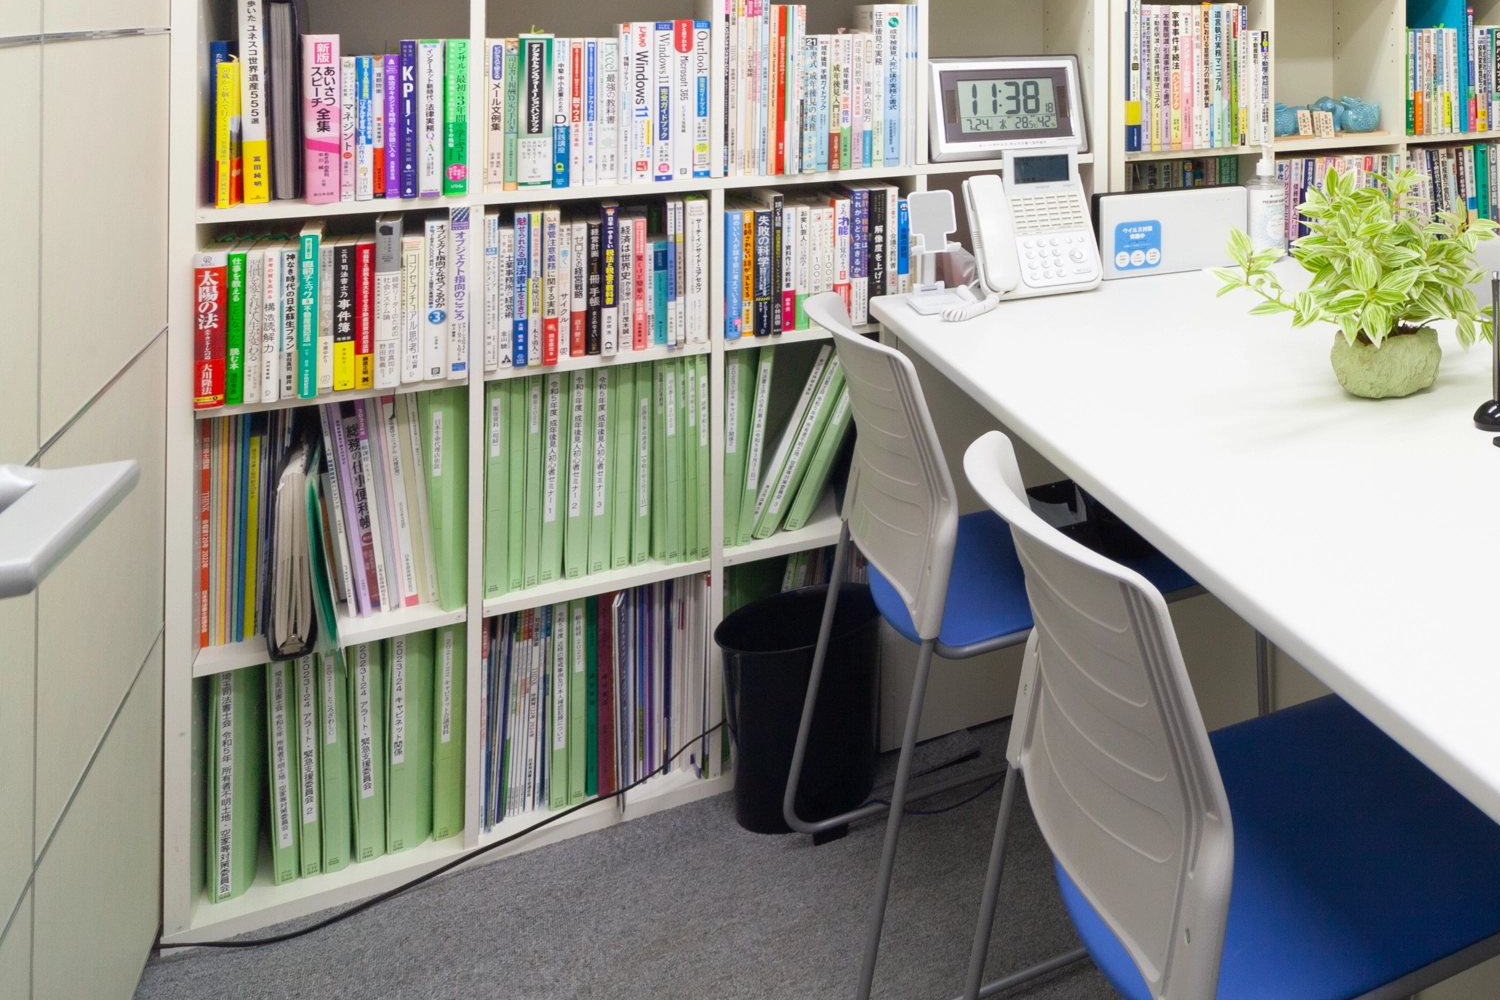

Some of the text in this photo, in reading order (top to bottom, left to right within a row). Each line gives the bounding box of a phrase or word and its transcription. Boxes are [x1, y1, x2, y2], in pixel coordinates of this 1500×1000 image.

[315, 42, 332, 64] 新版
[659, 33, 670, 75] Windows
[697, 31, 708, 74] Outlook
[855, 41, 863, 85] 成年後見教室
[875, 12, 883, 66] 任意後見の実務
[1172, 11, 1180, 70] 家事事件手続法
[1214, 11, 1222, 92] 遺言執行実務マニュアル
[311, 66, 323, 107] スピーチ
[324, 66, 336, 106] あいさつ
[605, 42, 618, 124] Excel 最強の教科書
[635, 51, 649, 117] Windows 11
[680, 55, 689, 87] Microsoft
[833, 64, 841, 113] 成年後見入門
[972, 81, 1040, 115] 11:38
[316, 108, 331, 133] 全集
[490, 83, 501, 132] メール文例集
[808, 72, 817, 132] 成年後見の実務
[999, 119, 1007, 130] 水
[1045, 103, 1053, 113] 18
[757, 215, 770, 268] 失敗の科学
[853, 192, 861, 273] これからどう生きるか
[861, 192, 869, 249] 会計士・税理士は
[1122, 226, 1153, 234] ウイルス対策
[435, 224, 446, 308] オブジェクト指向でなぜつくるのか
[454, 231, 466, 320] オブジェクト指向のこころ
[516, 217, 527, 319] 魅せられたる司法書士を生きて
[546, 223, 556, 316] 善管注意義務に関する実務
[731, 213, 740, 316] 頭のいい人が話す前に考えていること
[198, 271, 218, 330] 太陽の法
[263, 303, 276, 354] 構造読解力
[285, 253, 296, 350] 神なき時代の日本蘇生プラン
[337, 265, 351, 333] 司法書士乃 事件簿
[391, 277, 399, 337] 経営リーダーのための
[408, 254, 418, 353] コンセプチュアル思考
[622, 317, 630, 334] 茂木誠
[202, 364, 213, 396] 大川隆法
[547, 419, 558, 505] 成年後見人初心者セミナー
[572, 414, 583, 499] 成年後見人初心者セミナー
[596, 415, 606, 499] 成年後見人初心者セミナー
[557, 611, 565, 639] 令和5年度
[360, 701, 372, 790] アラート・緊急支援委員会
[394, 696, 404, 757] キャビネット関係
[219, 673, 233, 893] 埼玉司法書士会 所有者不明土地・空家等対策委員会
[277, 741, 289, 831] 所有者不明土地・空家等対策委員会
[303, 712, 314, 804] アラート・緊急支援委員会
